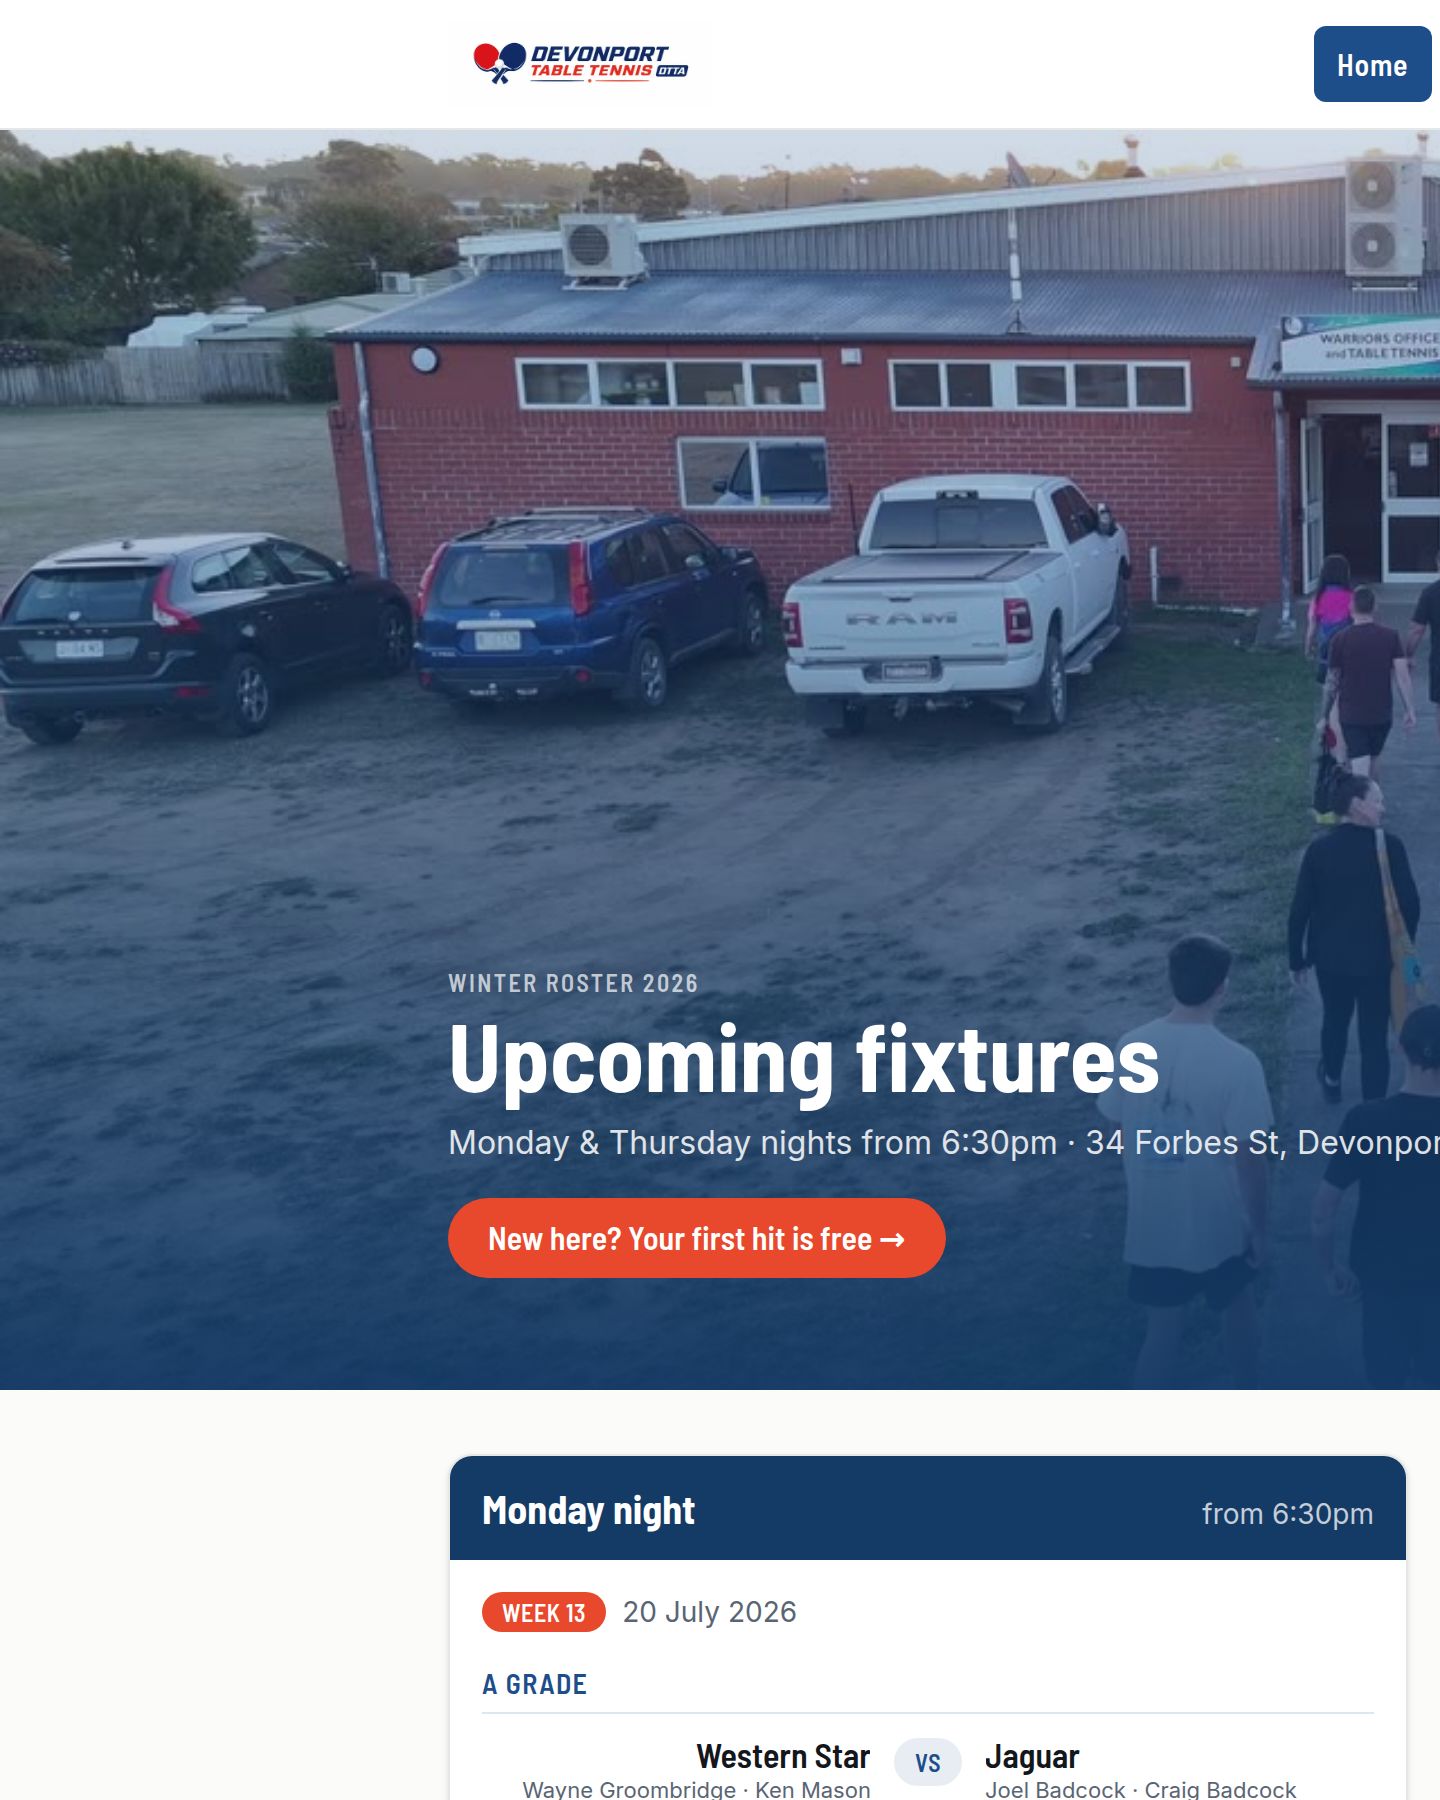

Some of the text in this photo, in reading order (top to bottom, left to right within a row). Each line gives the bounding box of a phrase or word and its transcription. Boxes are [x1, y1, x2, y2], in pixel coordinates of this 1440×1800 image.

[531, 46, 670, 62] DEVONPORT
[531, 64, 585, 76] TABLE
[590, 64, 653, 76] TENNIS
[1338, 53, 1408, 77] Home
[1320, 332, 1440, 344] WARRIORS OFFICE
[1325, 347, 1440, 359] and TABLE TENNIS
[846, 611, 959, 626] RAM
[483, 1494, 696, 1533] Monday night
[1201, 1501, 1373, 1531] from 6:30pm
[501, 1603, 586, 1623] WEEK 13
[623, 1600, 797, 1629] 20 July 2026
[482, 1673, 587, 1695] A GRADE
[696, 1743, 871, 1769] Western Star
[915, 1753, 941, 1773] VS
[985, 1743, 1081, 1776] Jaguar
[522, 1781, 871, 1800] Wayne Groombridge Ken Mason
[985, 1781, 1297, 1800] Joel Badcock Craig Badcock
